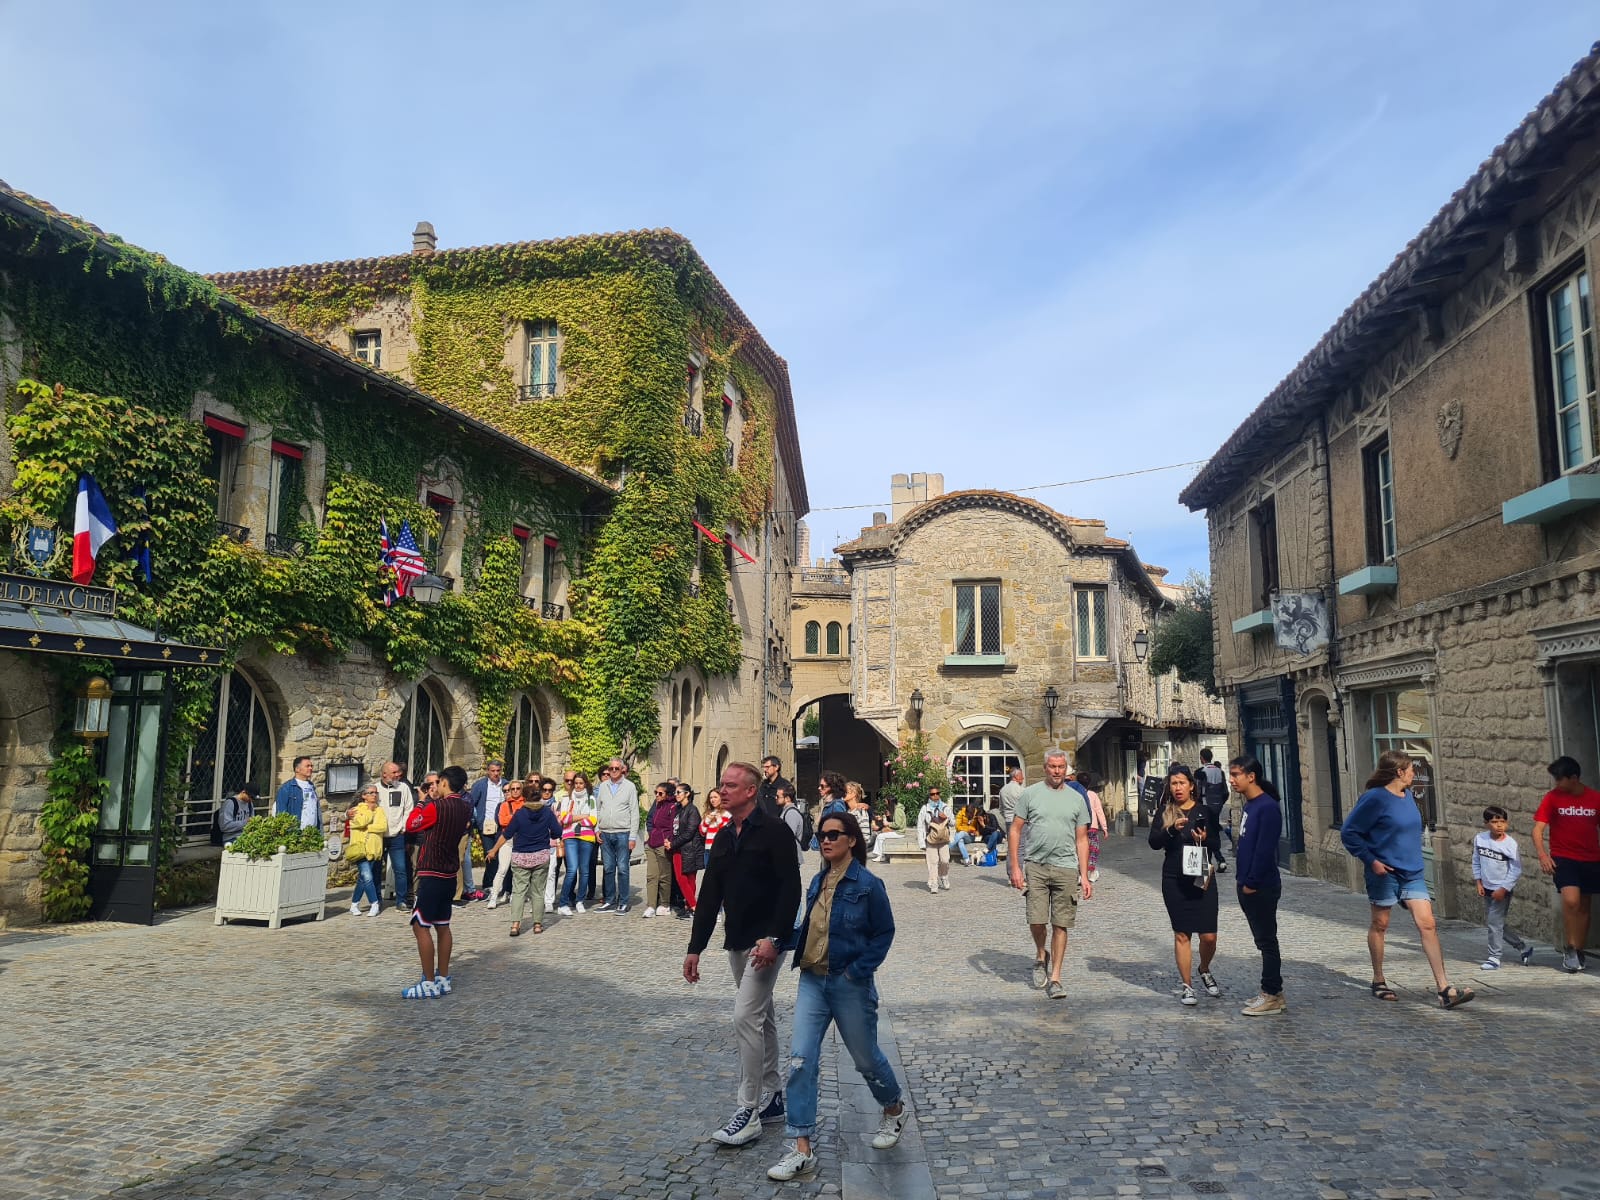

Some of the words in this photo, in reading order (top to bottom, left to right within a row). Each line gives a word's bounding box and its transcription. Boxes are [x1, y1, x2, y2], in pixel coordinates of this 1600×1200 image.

[18, 584, 42, 603] DE
[44, 588, 67, 606] LA
[1558, 805, 1597, 816] adidas
